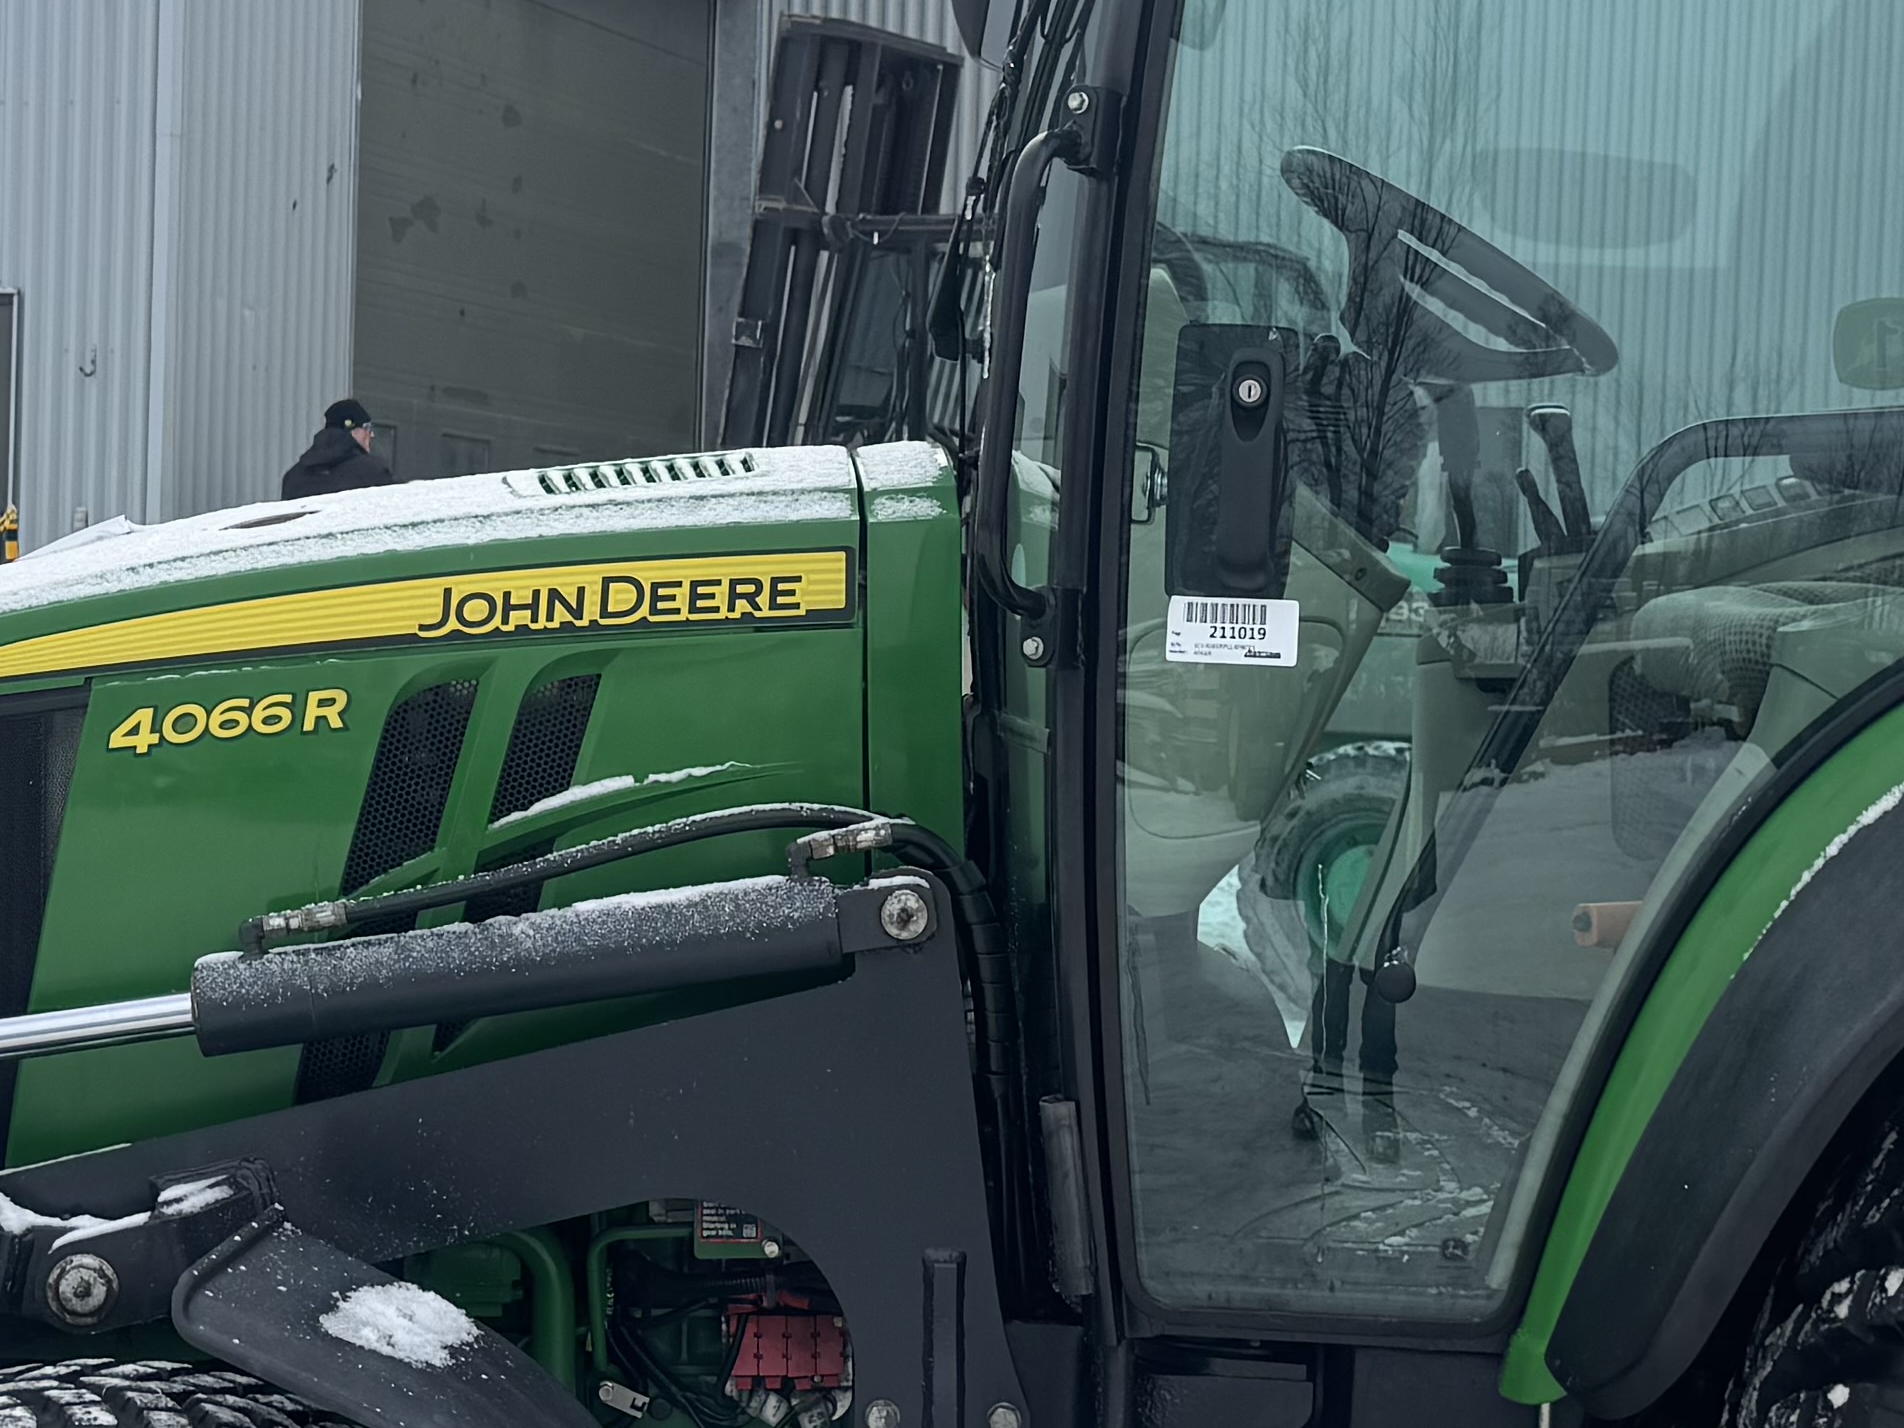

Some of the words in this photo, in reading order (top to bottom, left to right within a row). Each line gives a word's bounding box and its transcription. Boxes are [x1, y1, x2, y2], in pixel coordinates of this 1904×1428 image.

[417, 586, 586, 633] JOHN
[599, 575, 803, 620] DEERE
[1209, 625, 1267, 640] 211019
